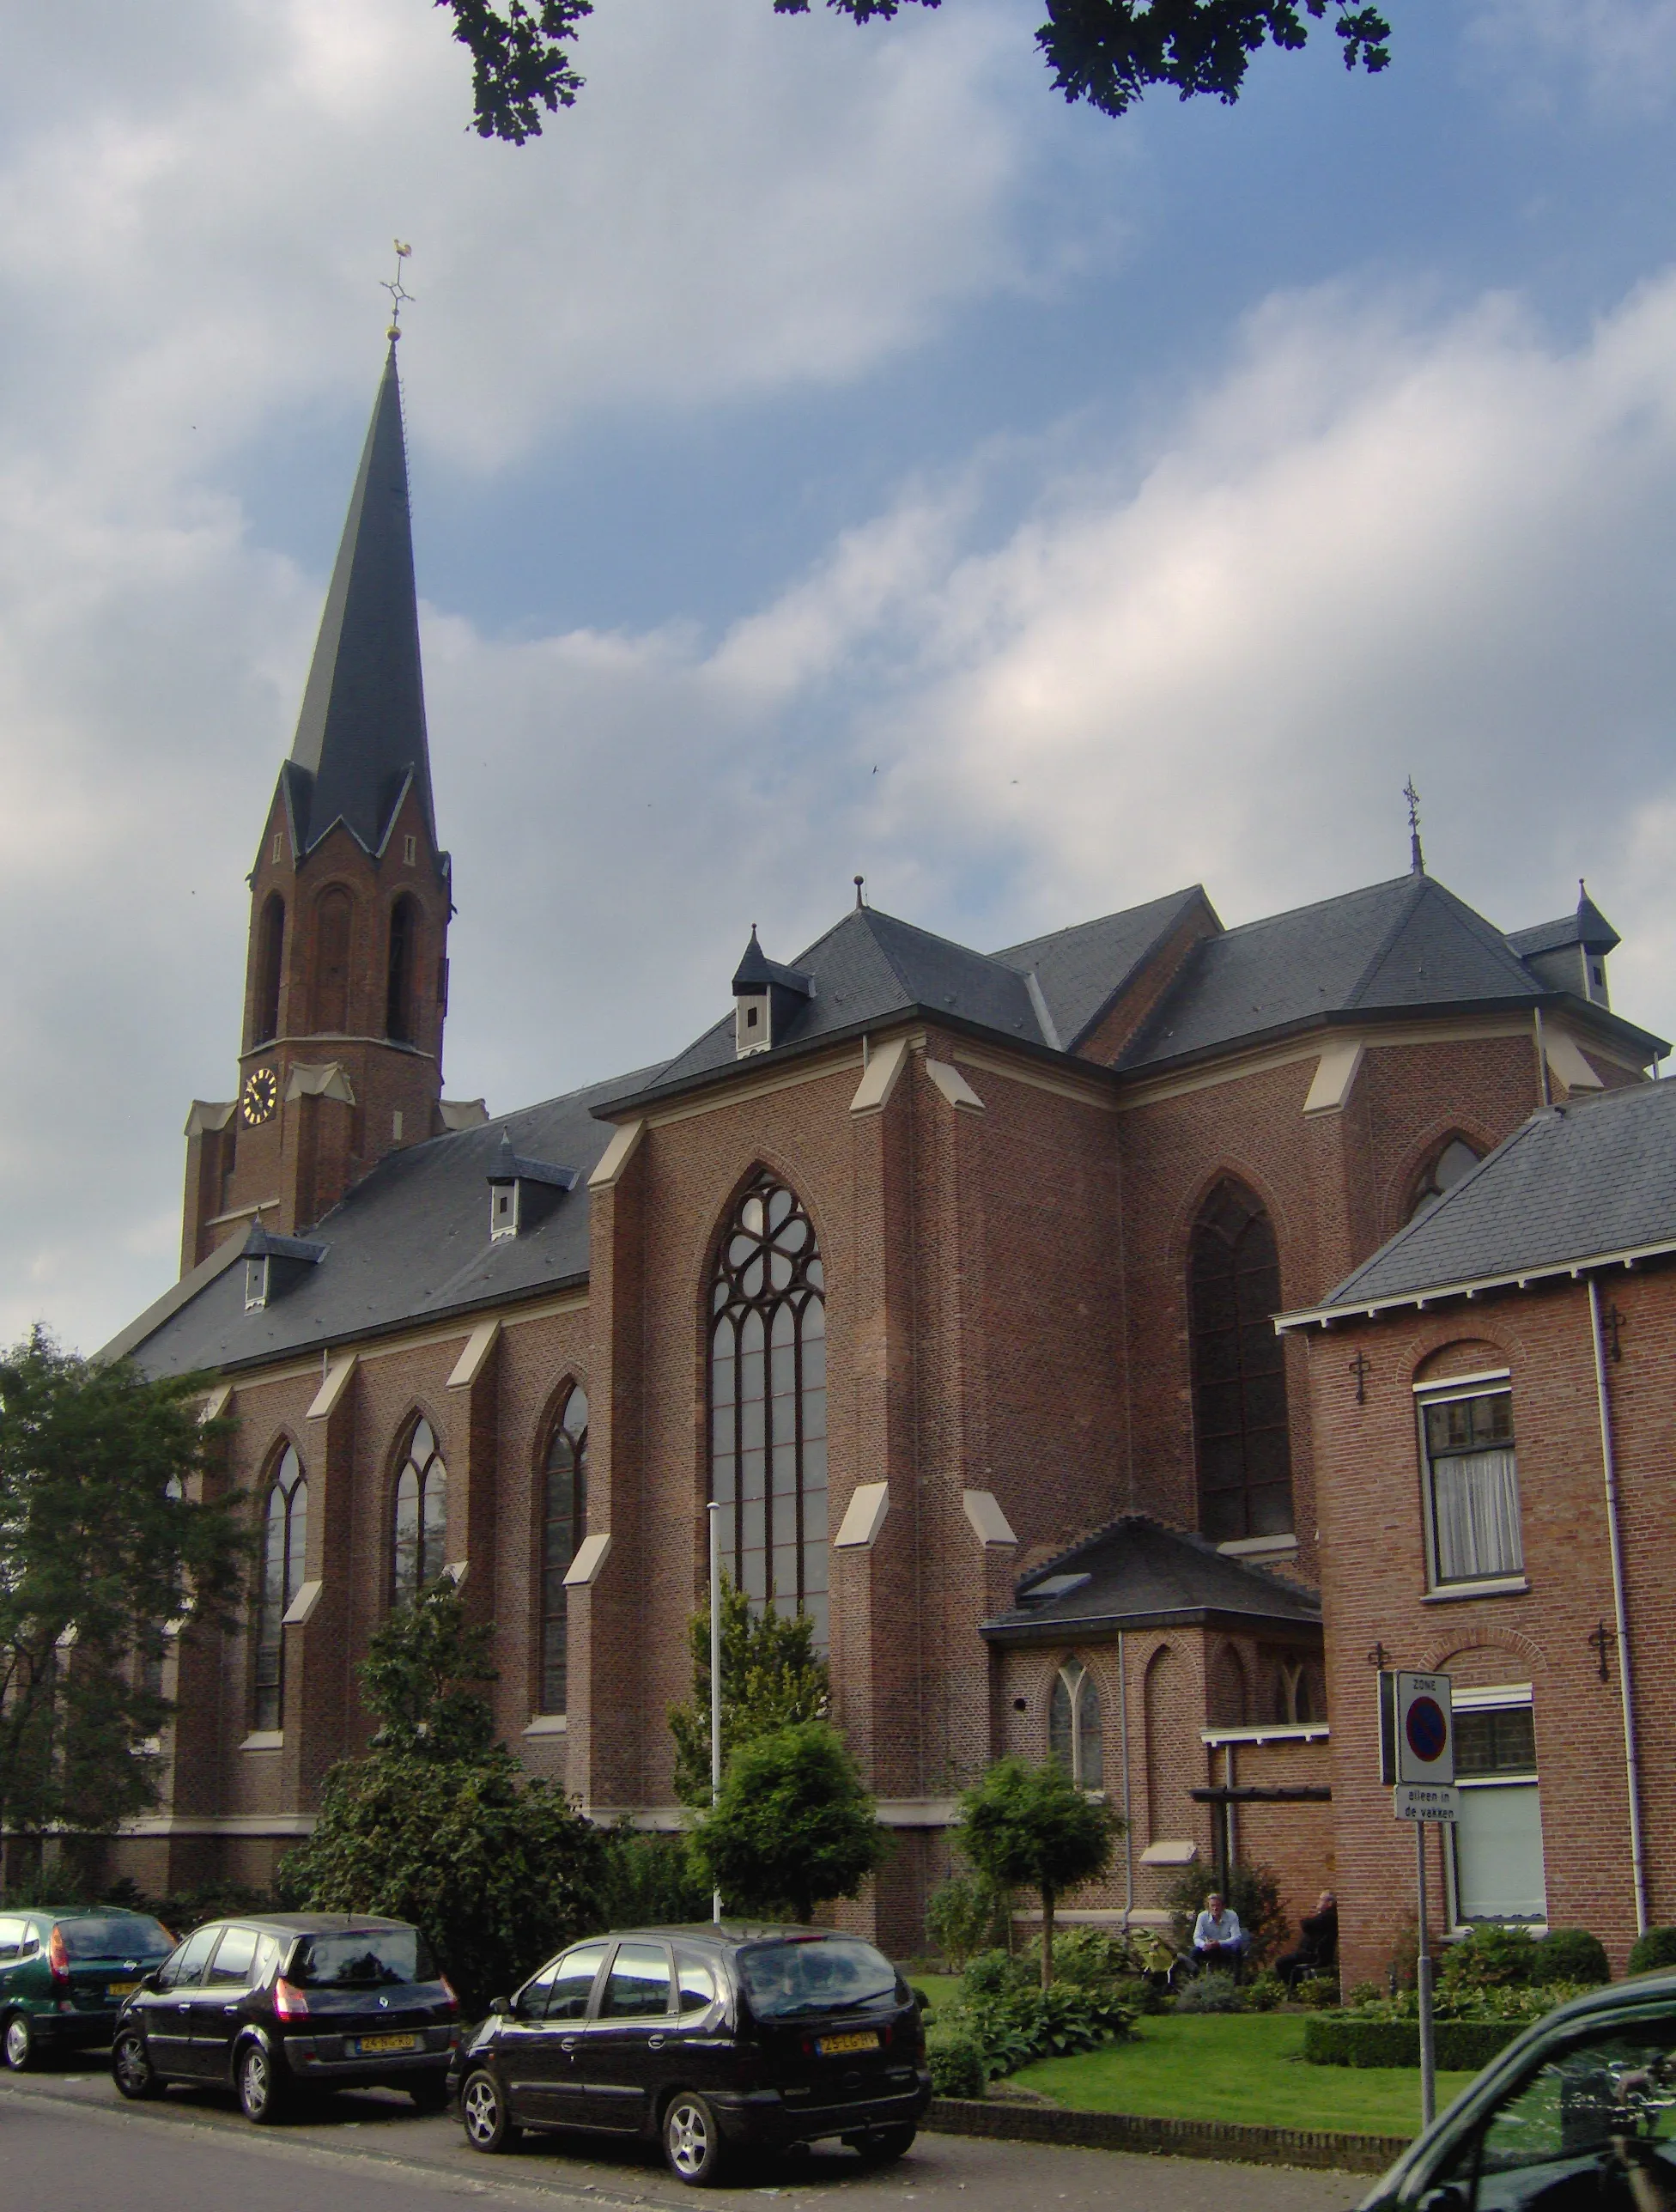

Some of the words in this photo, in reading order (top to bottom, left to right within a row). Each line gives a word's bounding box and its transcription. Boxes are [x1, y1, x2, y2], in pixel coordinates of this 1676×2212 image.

[1413, 1678, 1436, 1691] ZONE
[1408, 1790, 1437, 1802] alleen
[1441, 1791, 1450, 1802] in
[1405, 1805, 1417, 1817] de
[1421, 1807, 1454, 1819] vakken
